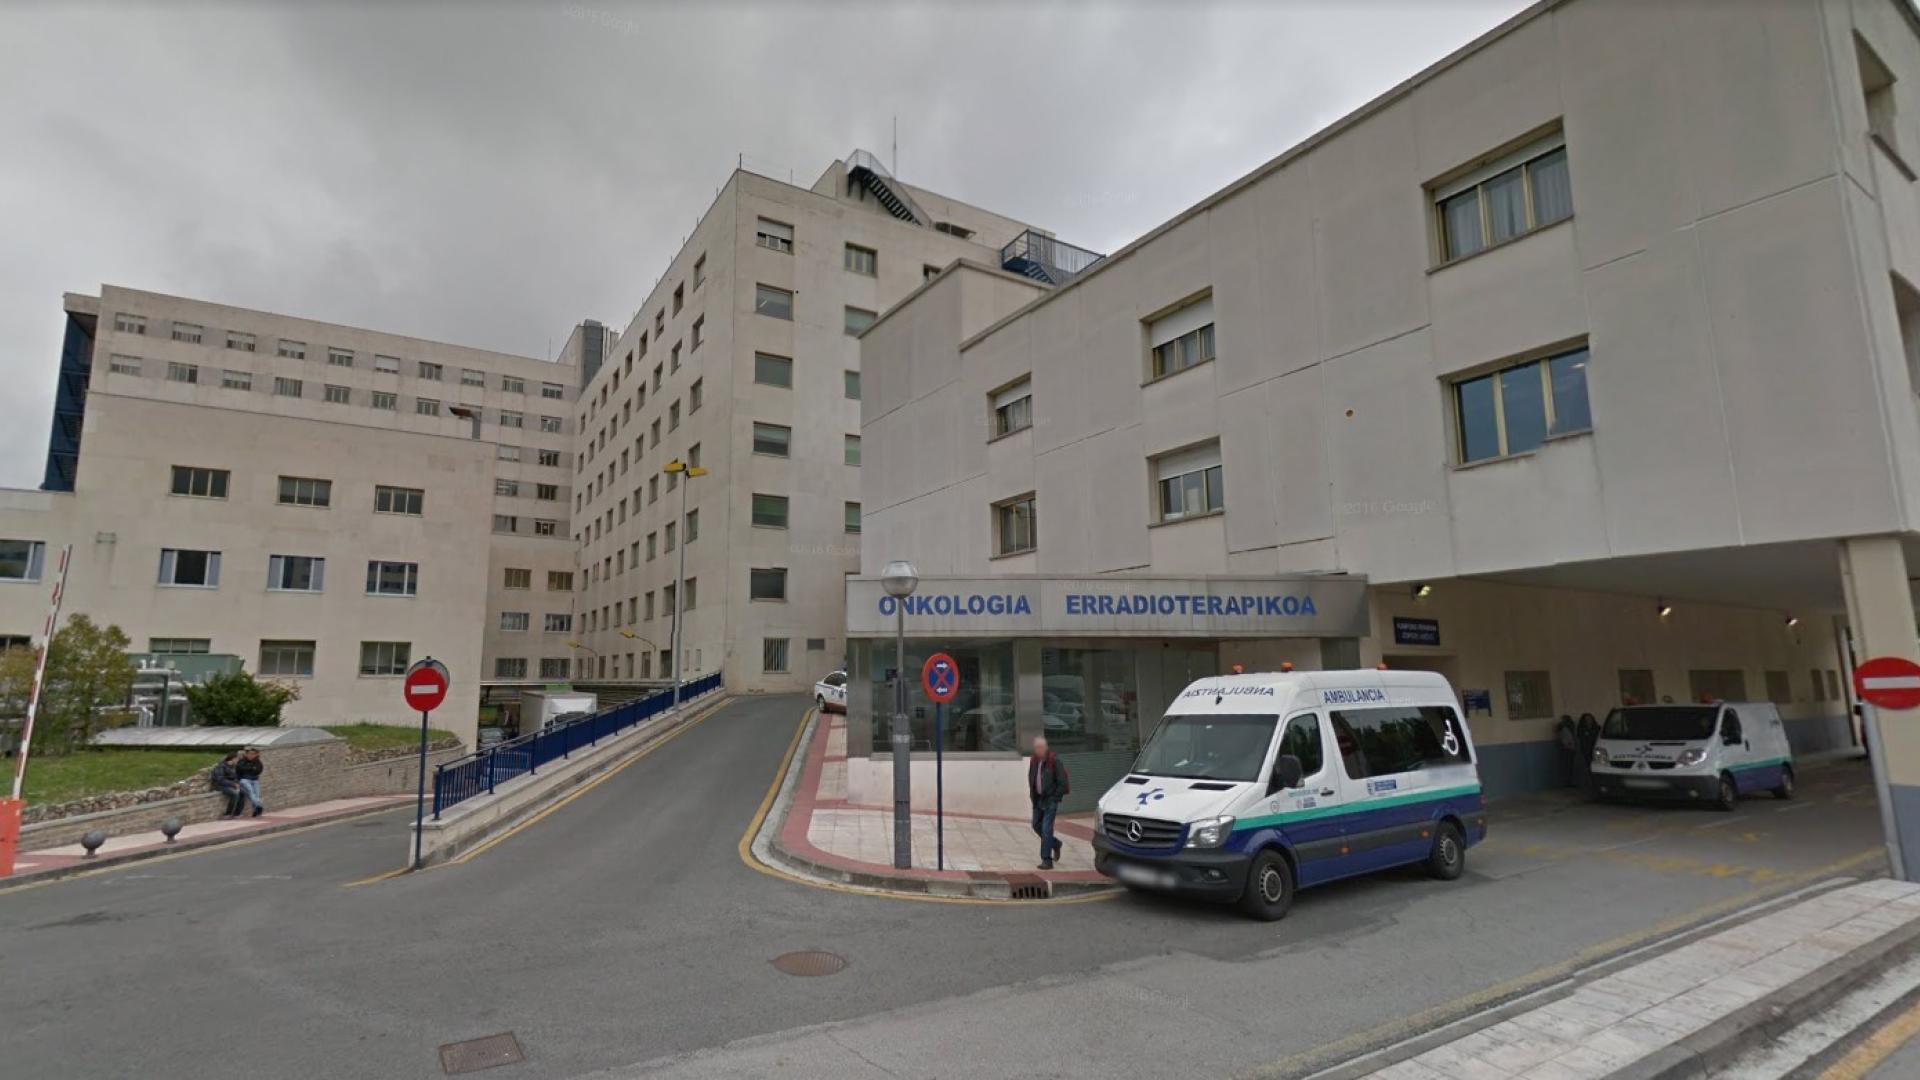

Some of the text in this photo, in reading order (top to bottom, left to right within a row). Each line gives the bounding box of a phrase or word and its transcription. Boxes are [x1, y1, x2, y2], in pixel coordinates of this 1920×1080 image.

[878, 594, 1318, 617] ONKOLOGIA ERRADIOTERAPIKOA
[1323, 688, 1386, 704] AMBULANCIA
